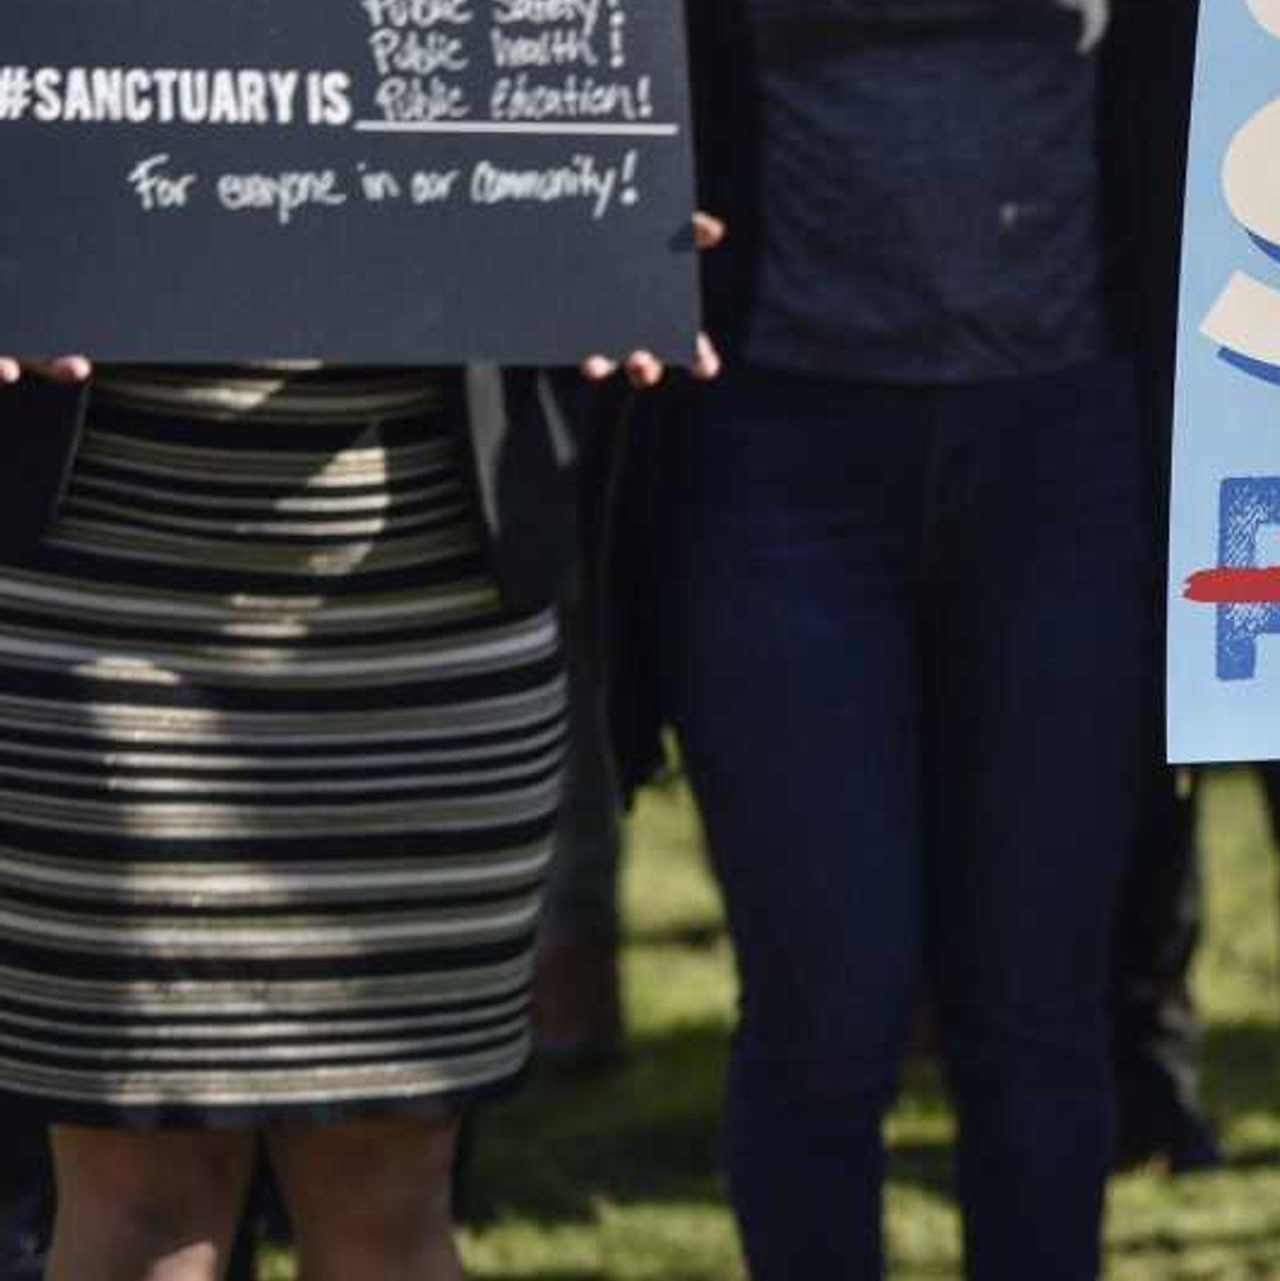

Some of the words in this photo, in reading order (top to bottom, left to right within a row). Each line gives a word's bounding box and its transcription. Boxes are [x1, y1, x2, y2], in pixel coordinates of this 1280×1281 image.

[368, 28, 469, 74] Public
[0, 66, 299, 124] #SANCTUARY
[307, 71, 352, 126] IS
[375, 76, 472, 122] Public
[128, 154, 195, 210] For
[357, 162, 399, 200] in
[410, 170, 460, 203] our
